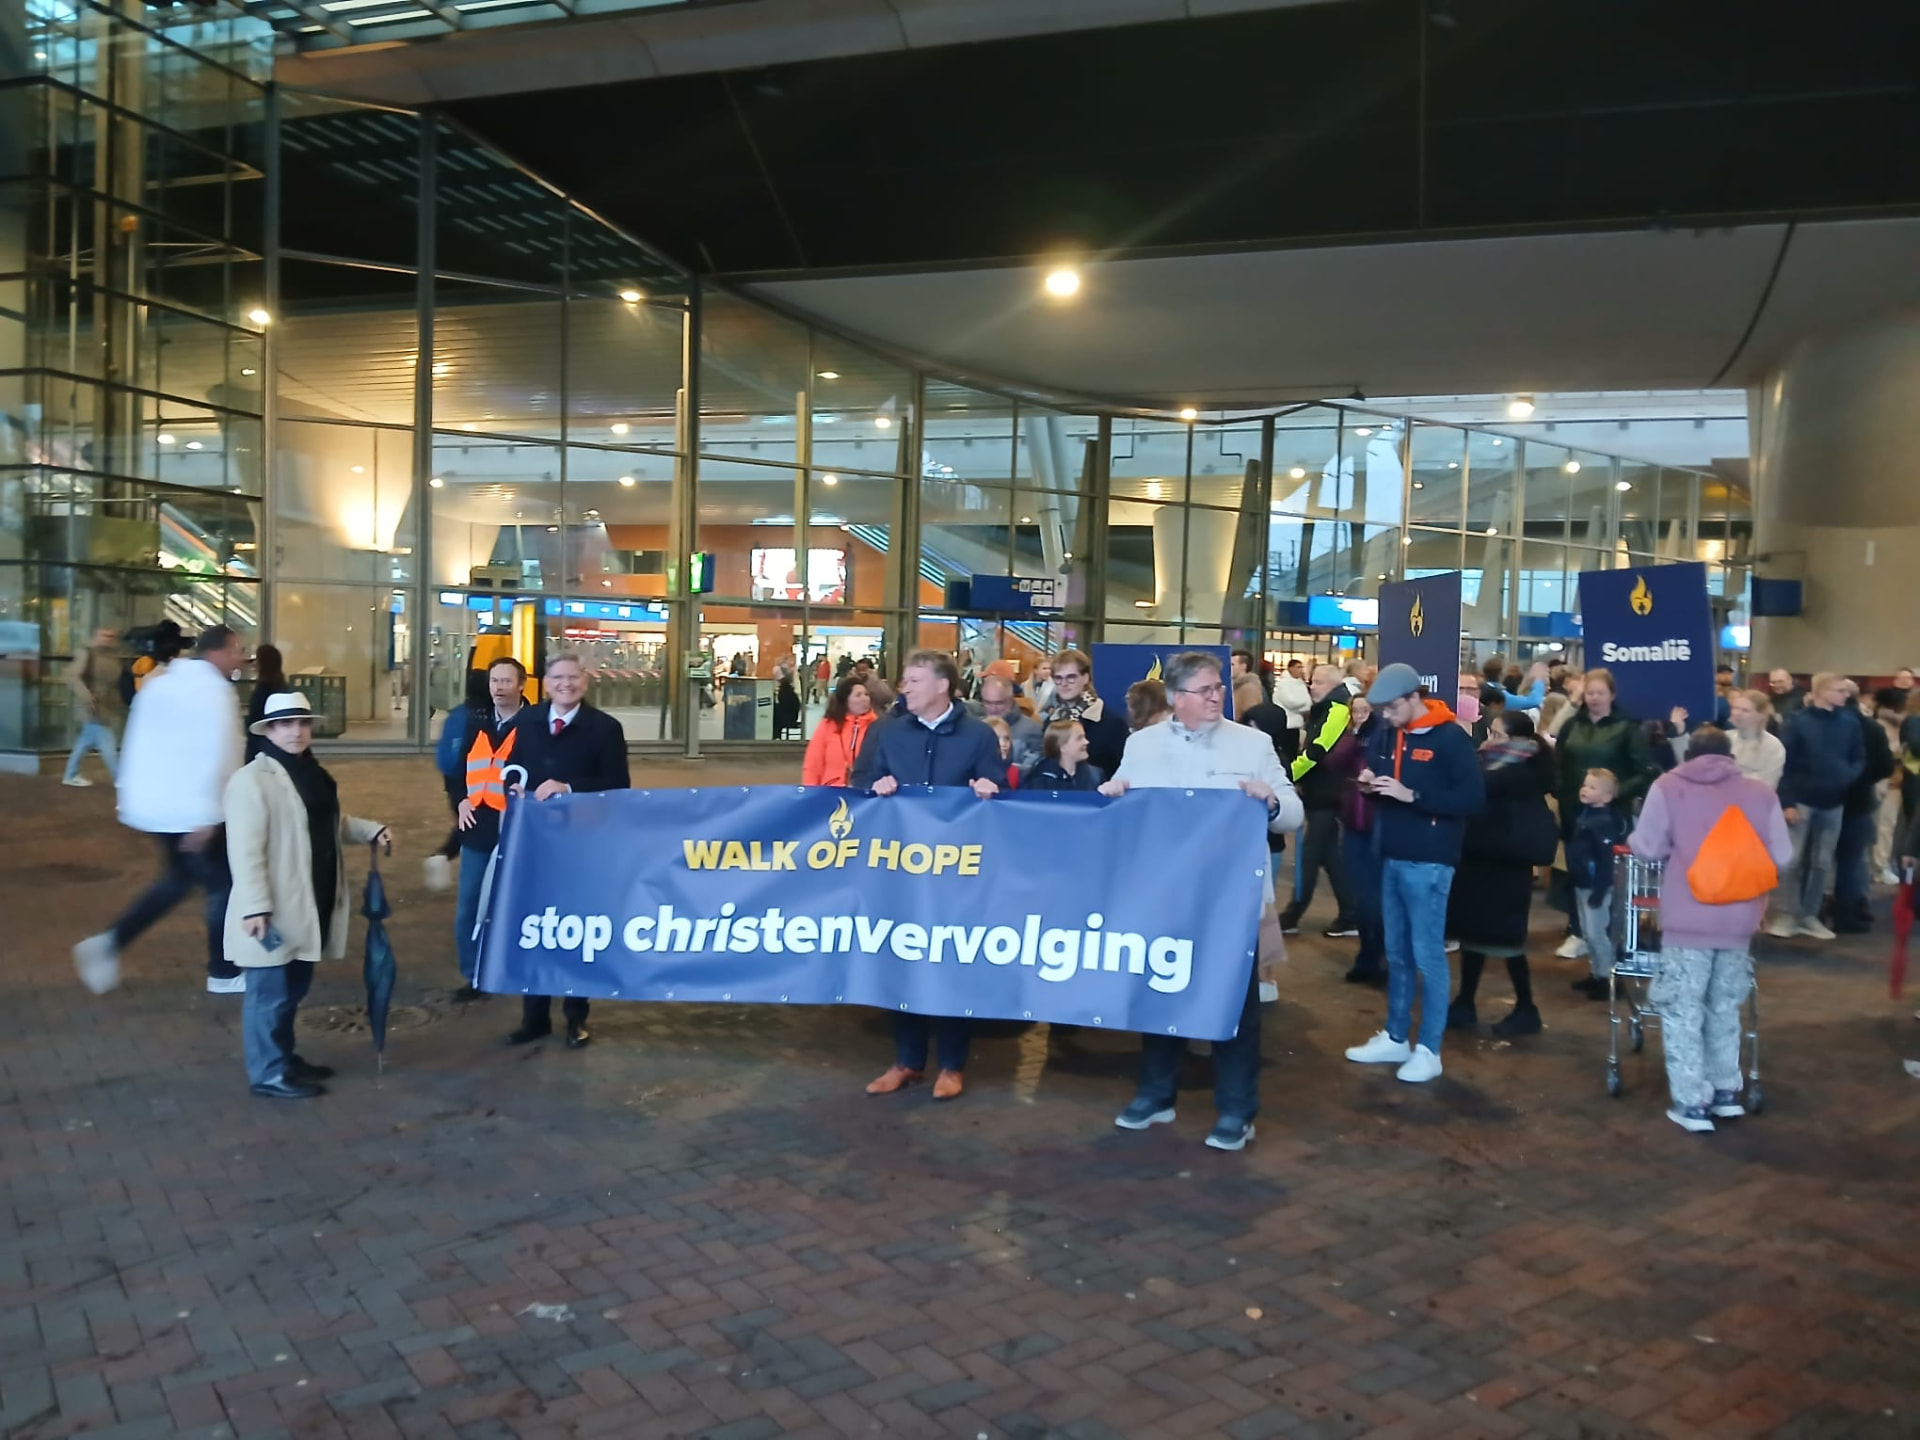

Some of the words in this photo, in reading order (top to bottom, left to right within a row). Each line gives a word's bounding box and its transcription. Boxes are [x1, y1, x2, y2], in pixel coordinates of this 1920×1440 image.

[1602, 639, 1691, 662] Somalië
[683, 839, 799, 871] WALK
[806, 838, 860, 870] OF
[867, 838, 983, 875] HOPE
[518, 906, 613, 963] stop
[623, 902, 1195, 994] christenvervolging
